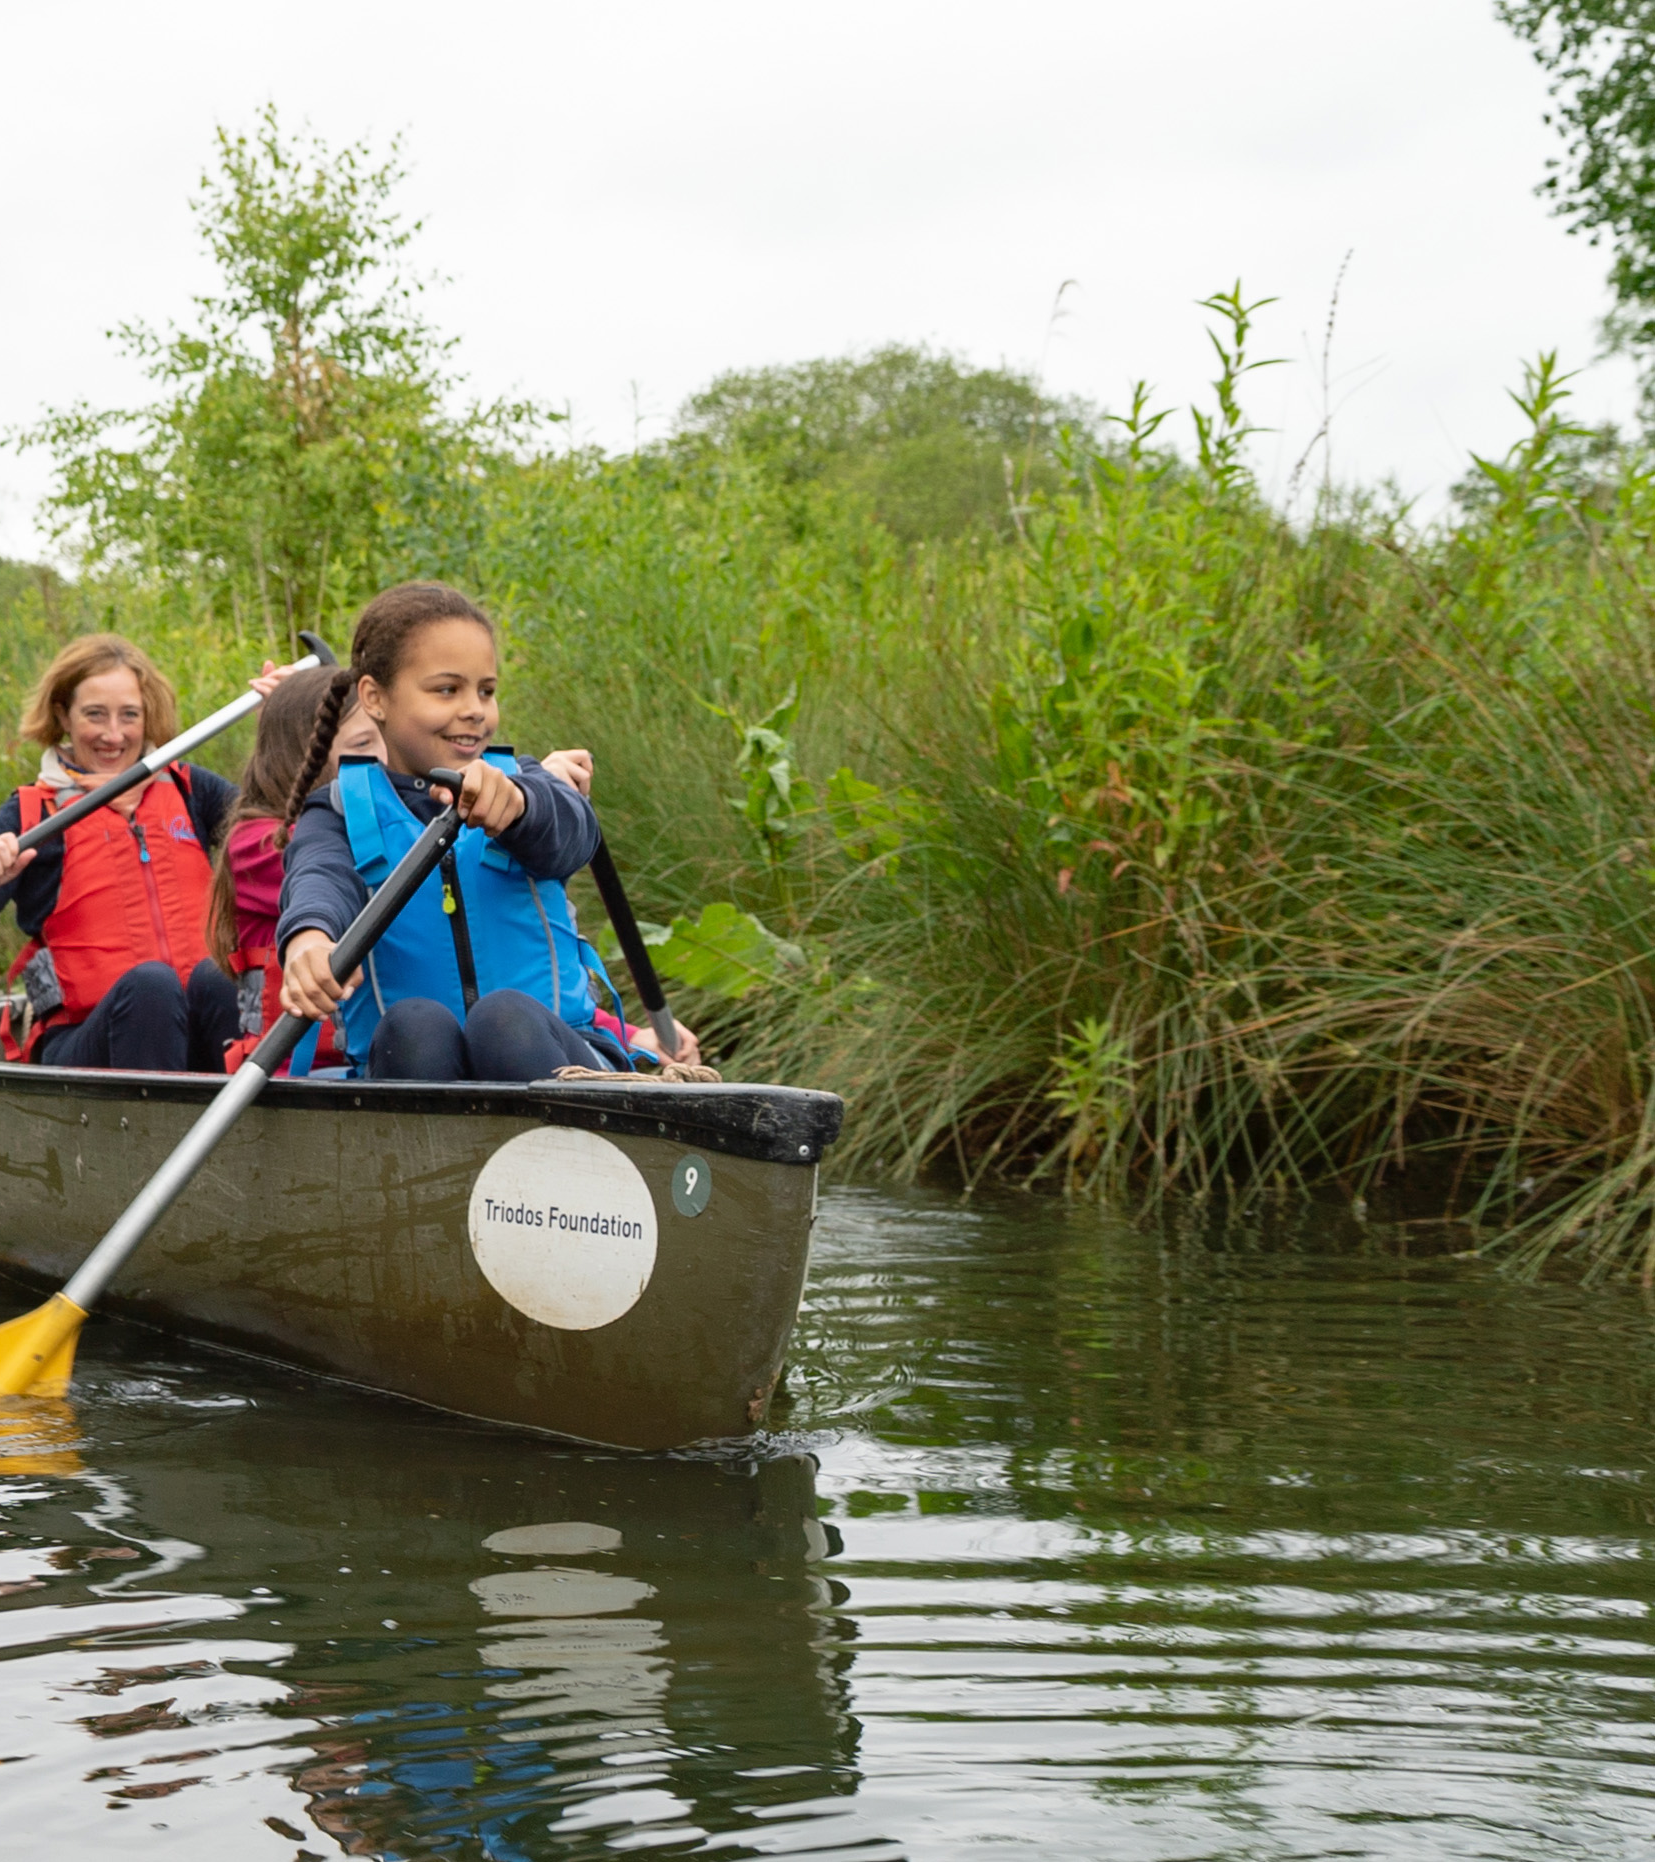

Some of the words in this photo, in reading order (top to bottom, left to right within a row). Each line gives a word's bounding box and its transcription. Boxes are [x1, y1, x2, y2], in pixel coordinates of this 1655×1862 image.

[685, 1166, 698, 1196] 9
[484, 1198, 544, 1227] Triodos
[548, 1206, 642, 1240] Foundation
